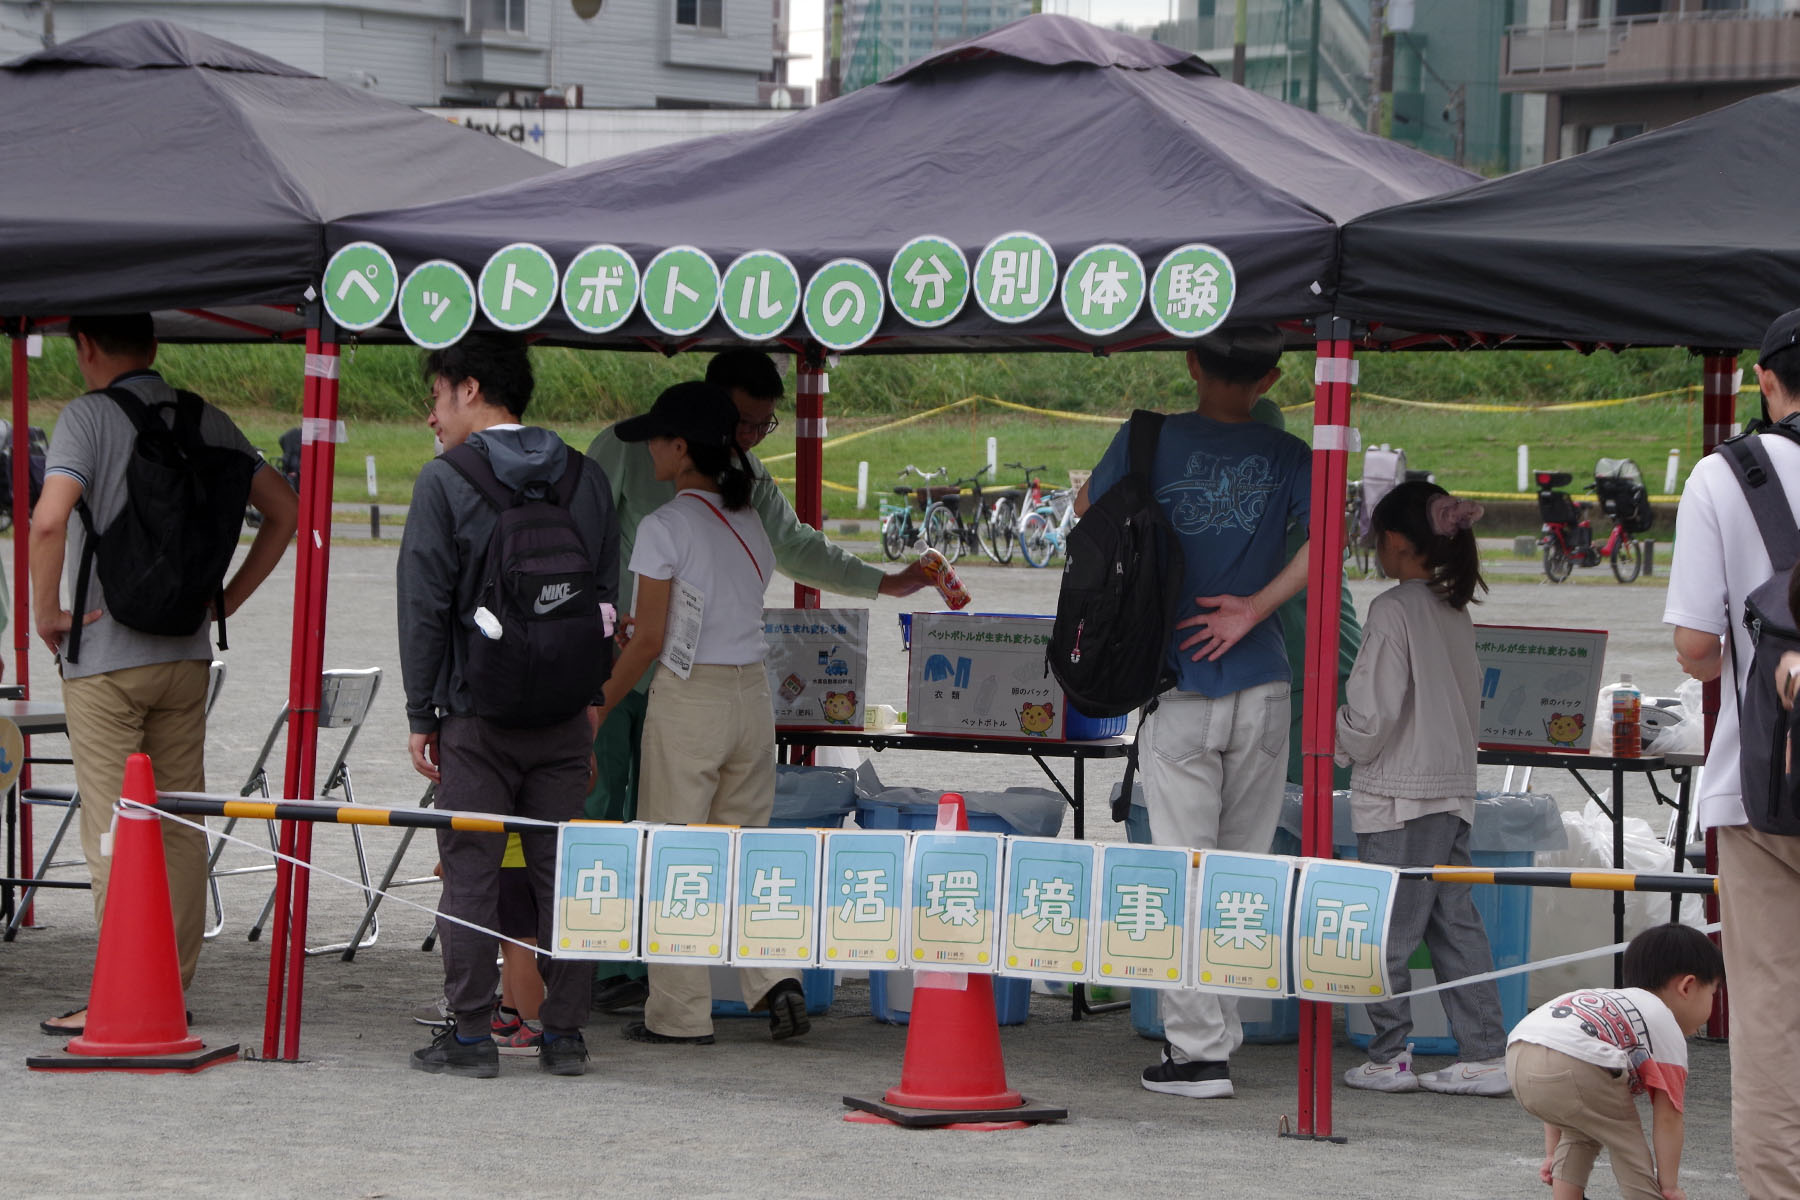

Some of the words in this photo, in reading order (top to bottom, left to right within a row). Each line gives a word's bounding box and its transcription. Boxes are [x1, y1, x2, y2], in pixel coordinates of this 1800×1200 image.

[335, 249, 1220, 327] ペットボトルの分別体験
[540, 582, 572, 601] NIKE
[575, 858, 1370, 961] 中原生活環境事業所
